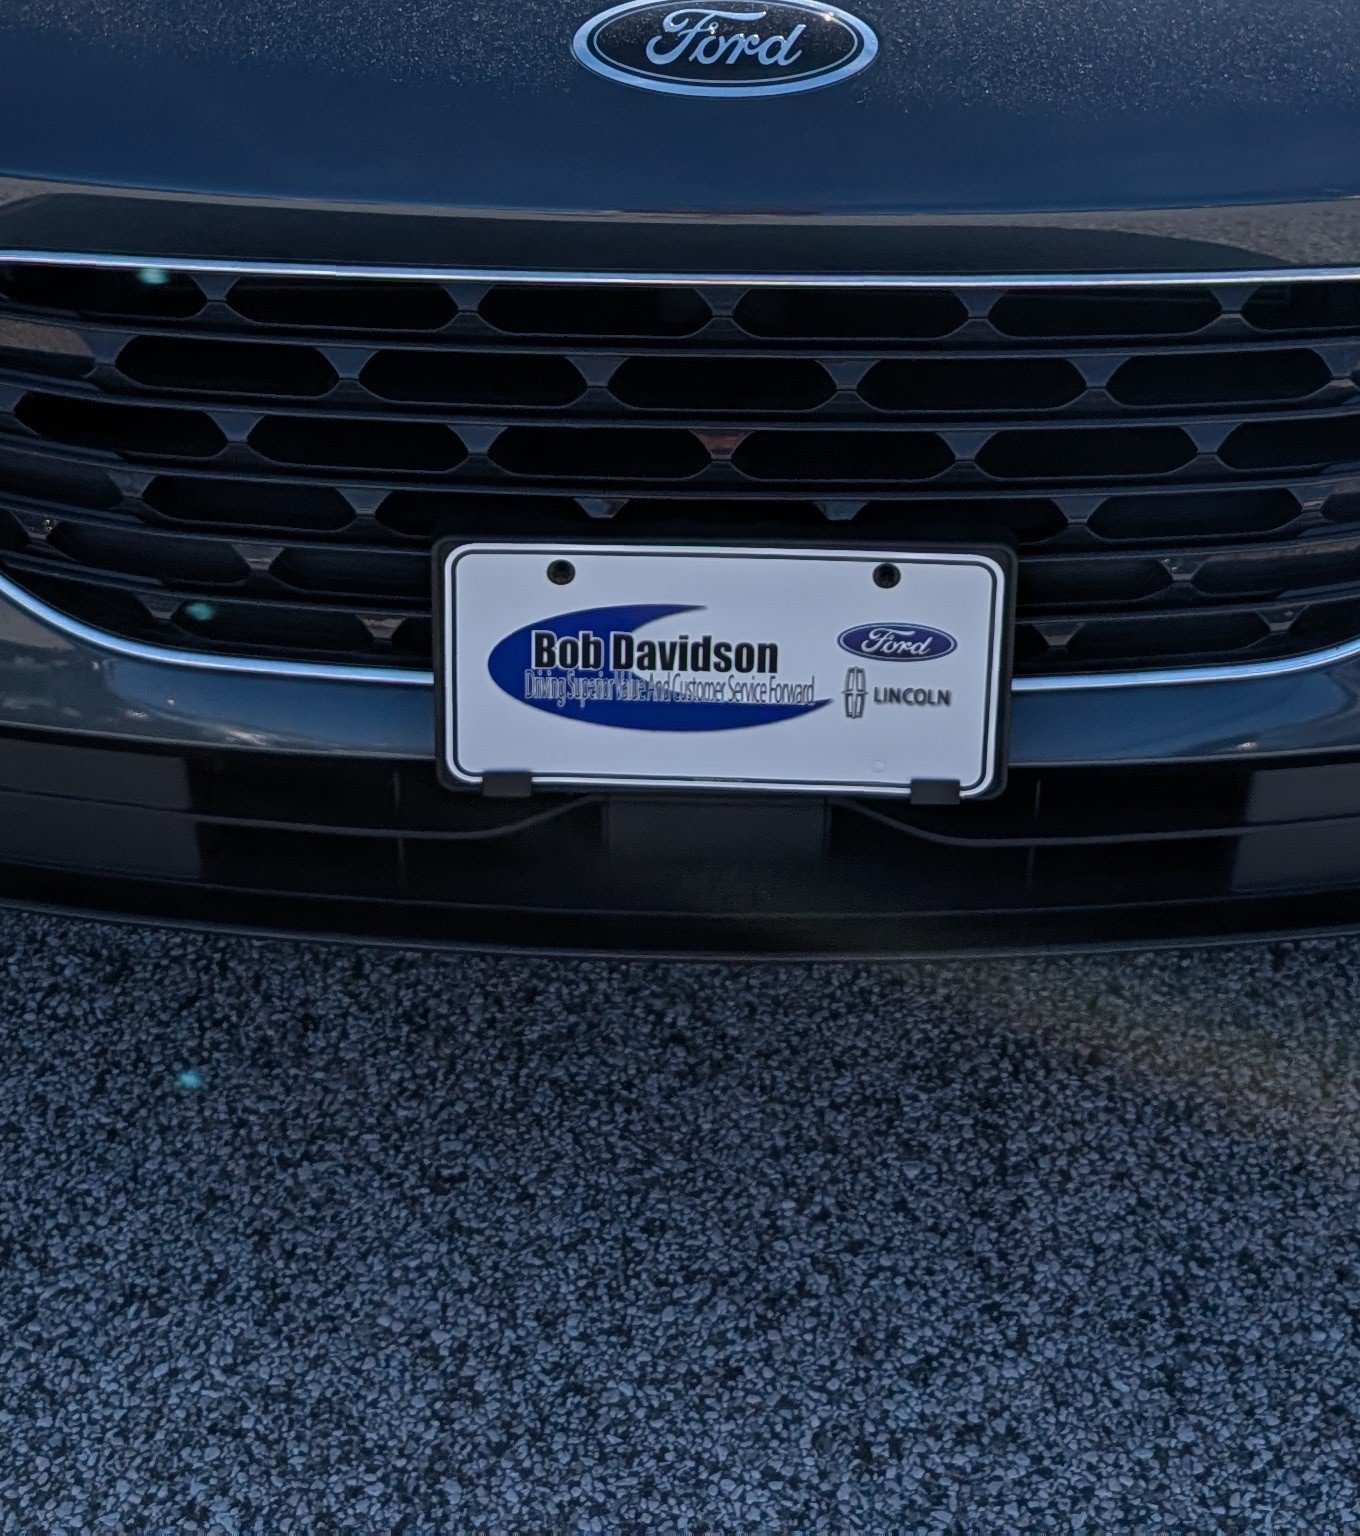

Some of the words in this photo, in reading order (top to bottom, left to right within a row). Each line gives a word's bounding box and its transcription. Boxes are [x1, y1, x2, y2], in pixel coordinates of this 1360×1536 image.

[645, 8, 807, 66] Ford
[533, 631, 604, 670] Bob
[612, 633, 779, 674] Davidson
[860, 627, 934, 655] Ford
[671, 672, 726, 704] Customer
[727, 673, 767, 704] Service
[768, 674, 817, 705] Forward
[873, 686, 952, 707] LINCOLN
